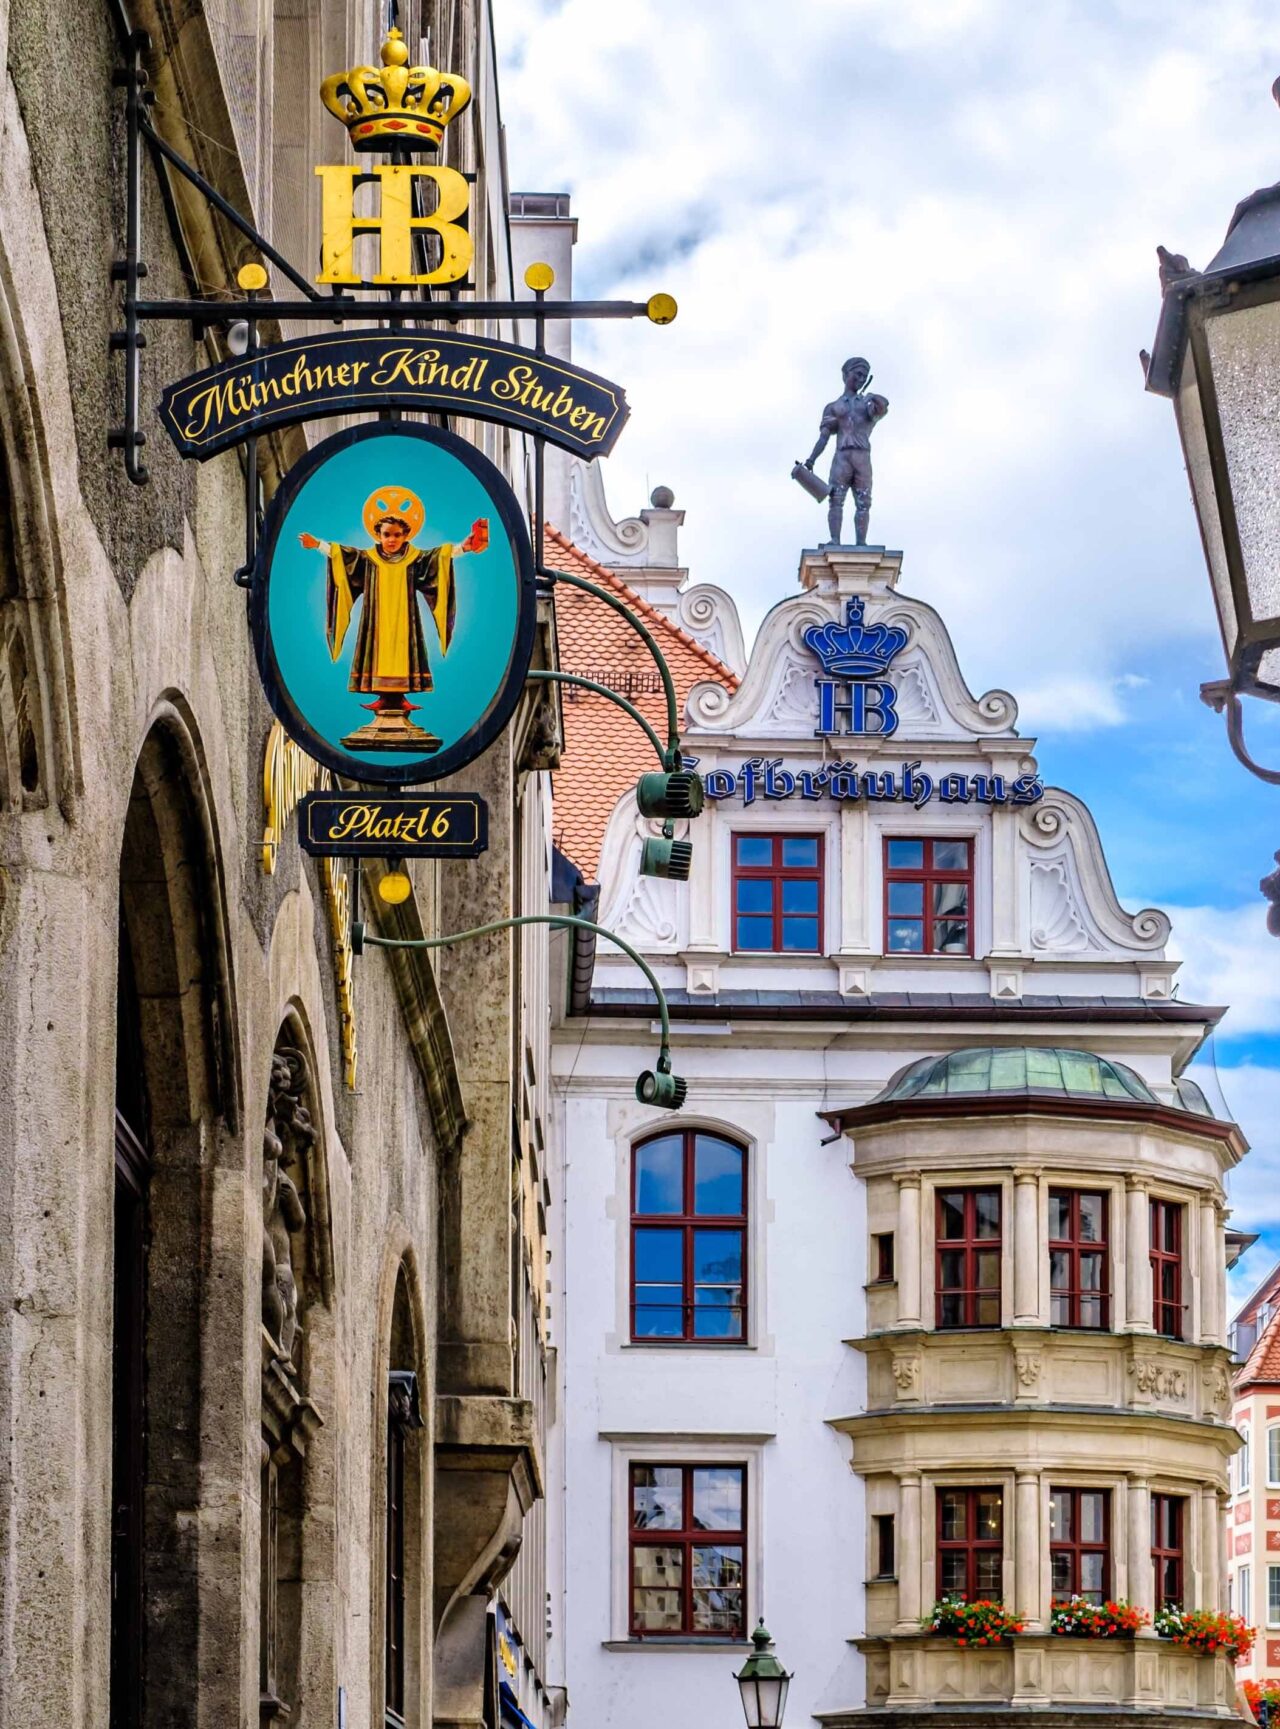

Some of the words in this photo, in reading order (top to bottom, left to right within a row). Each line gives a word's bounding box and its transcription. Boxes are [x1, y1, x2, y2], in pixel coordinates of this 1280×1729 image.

[315, 165, 475, 284] HB
[185, 354, 369, 438] Münchner
[371, 349, 488, 392] Kindl
[491, 366, 606, 438] Stuben
[815, 679, 899, 738] HB
[682, 756, 1044, 810] ofbräuhaus
